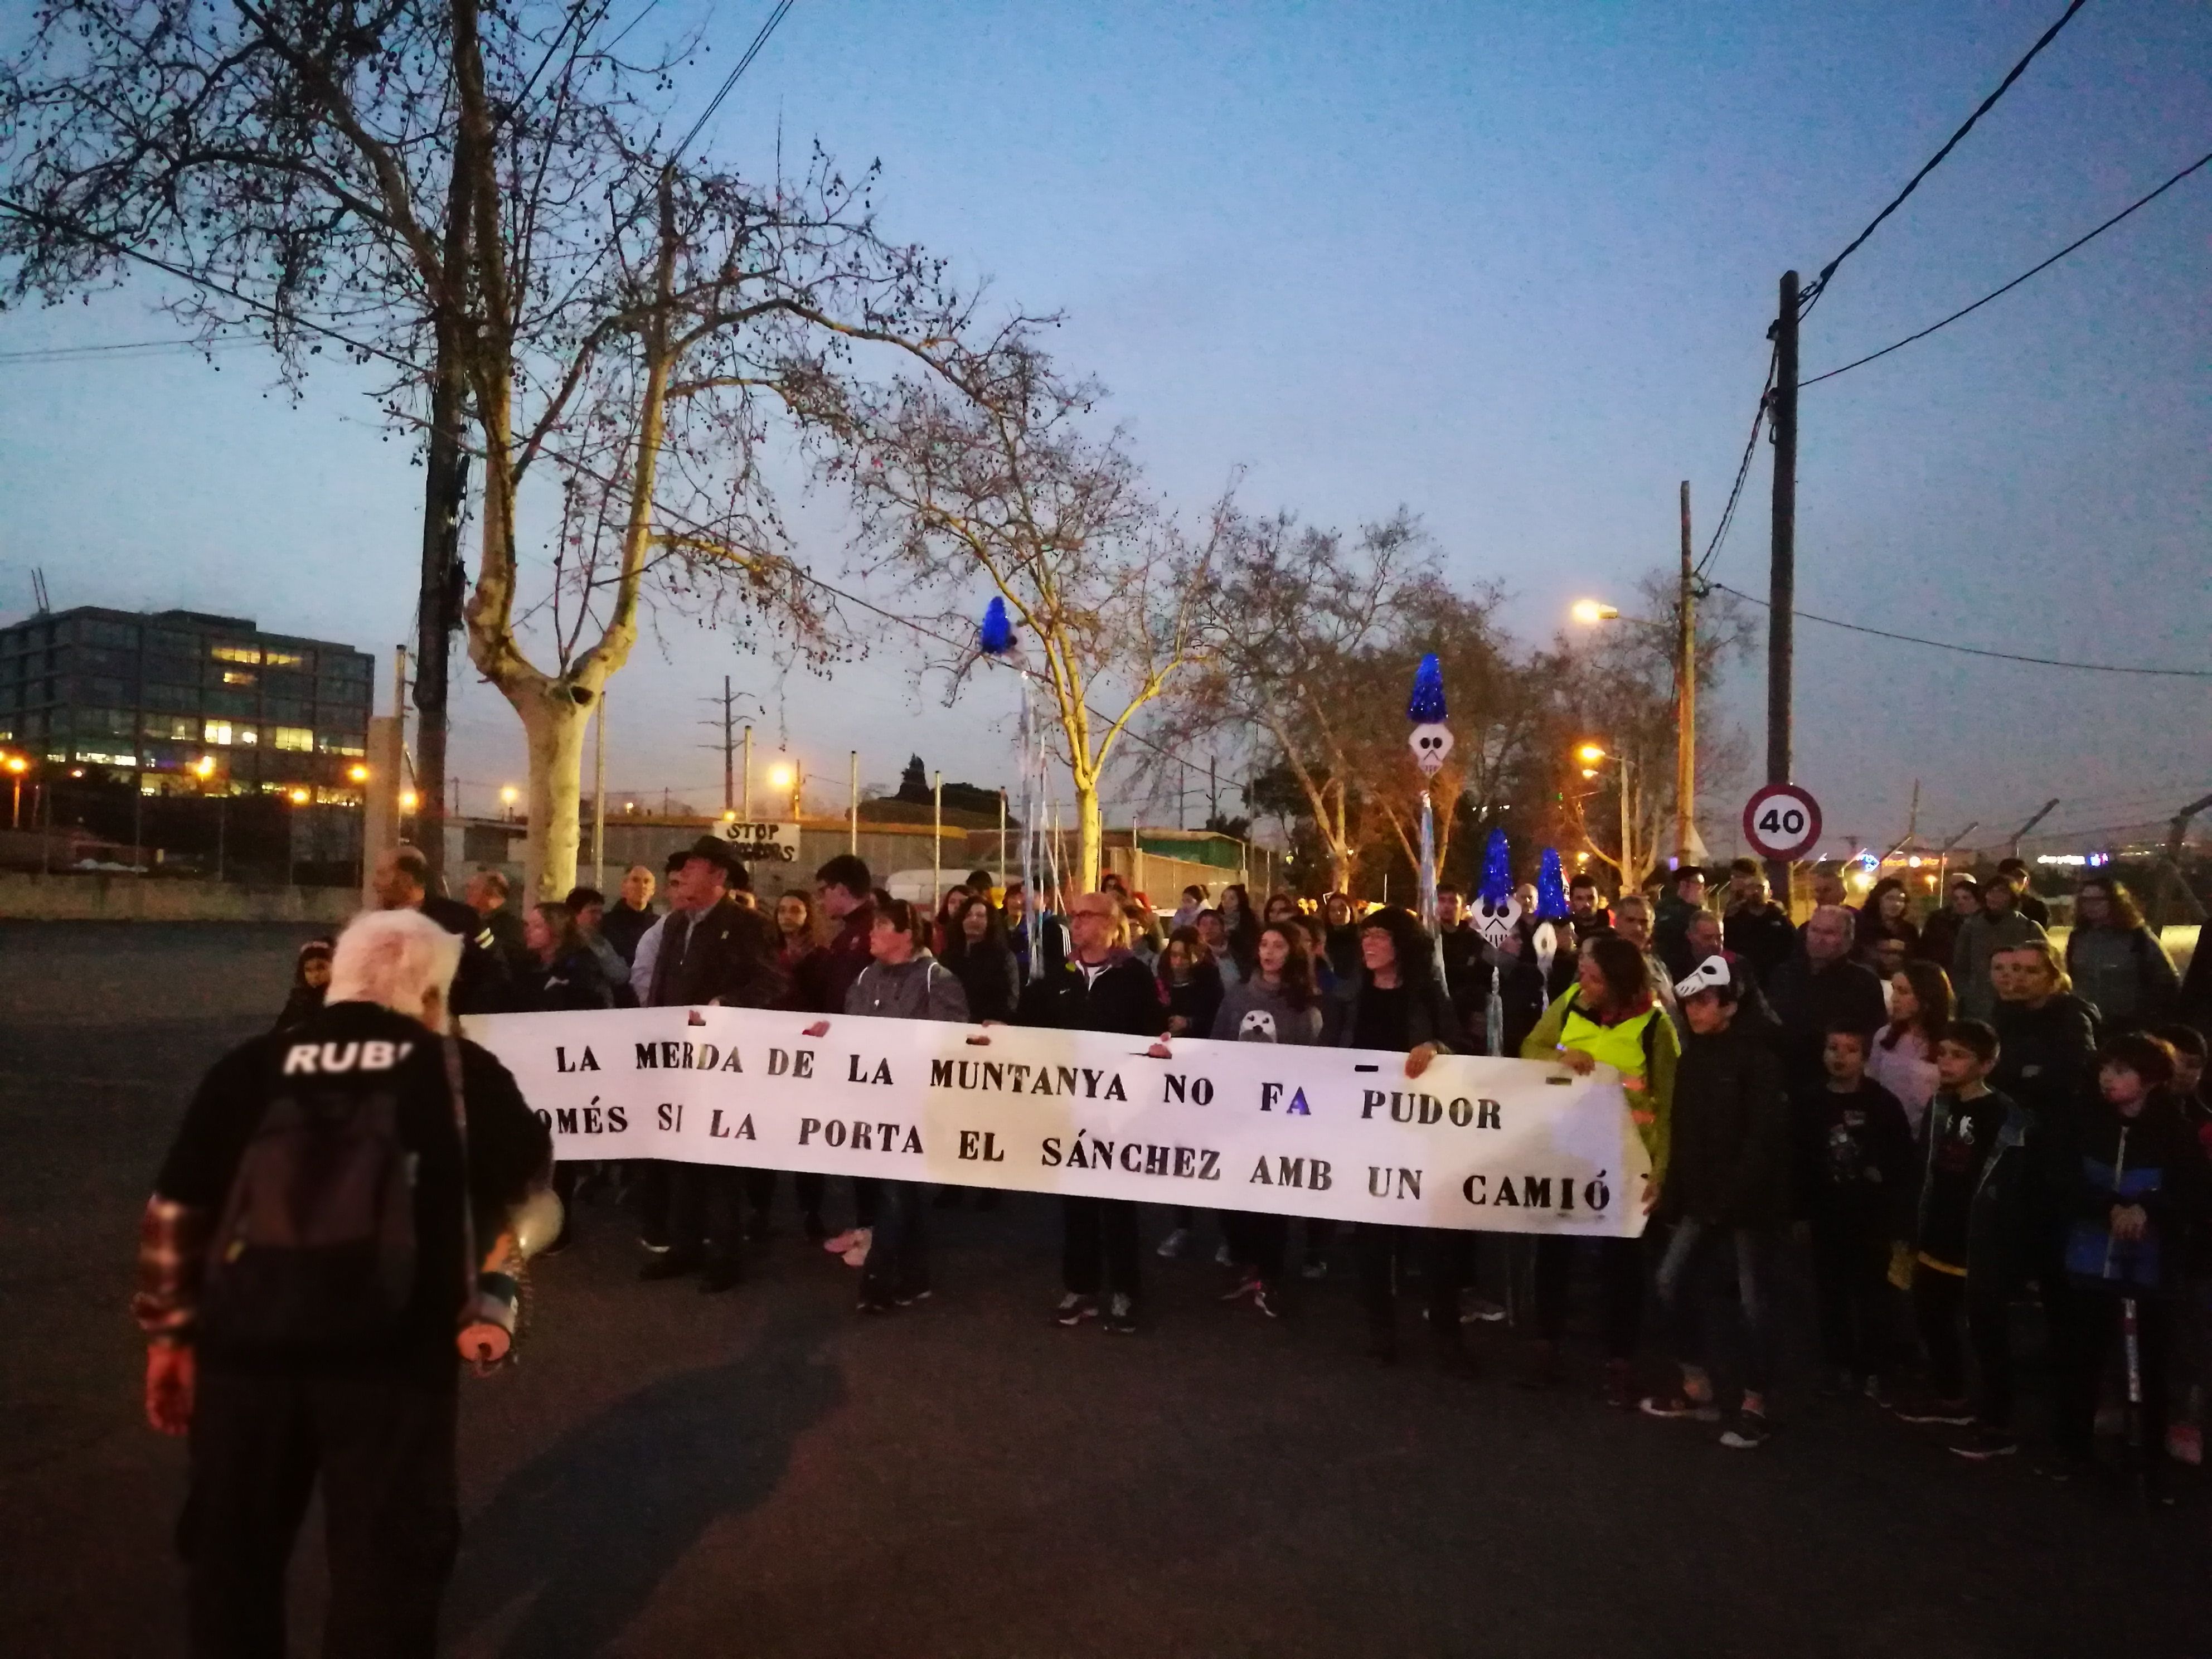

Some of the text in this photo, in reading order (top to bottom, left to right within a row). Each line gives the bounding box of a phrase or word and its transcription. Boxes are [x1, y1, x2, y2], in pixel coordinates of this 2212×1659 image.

[727, 823, 779, 840] STOP
[1759, 809, 1804, 834] 40
[556, 1041, 1501, 1130] LA MERDA DE LA MUNTANYA NO FA PUDOR
[534, 1095, 1611, 1211] OMÉS SI LA PORTA EL SÁNCHEZ AMB UN CAMIÓ
